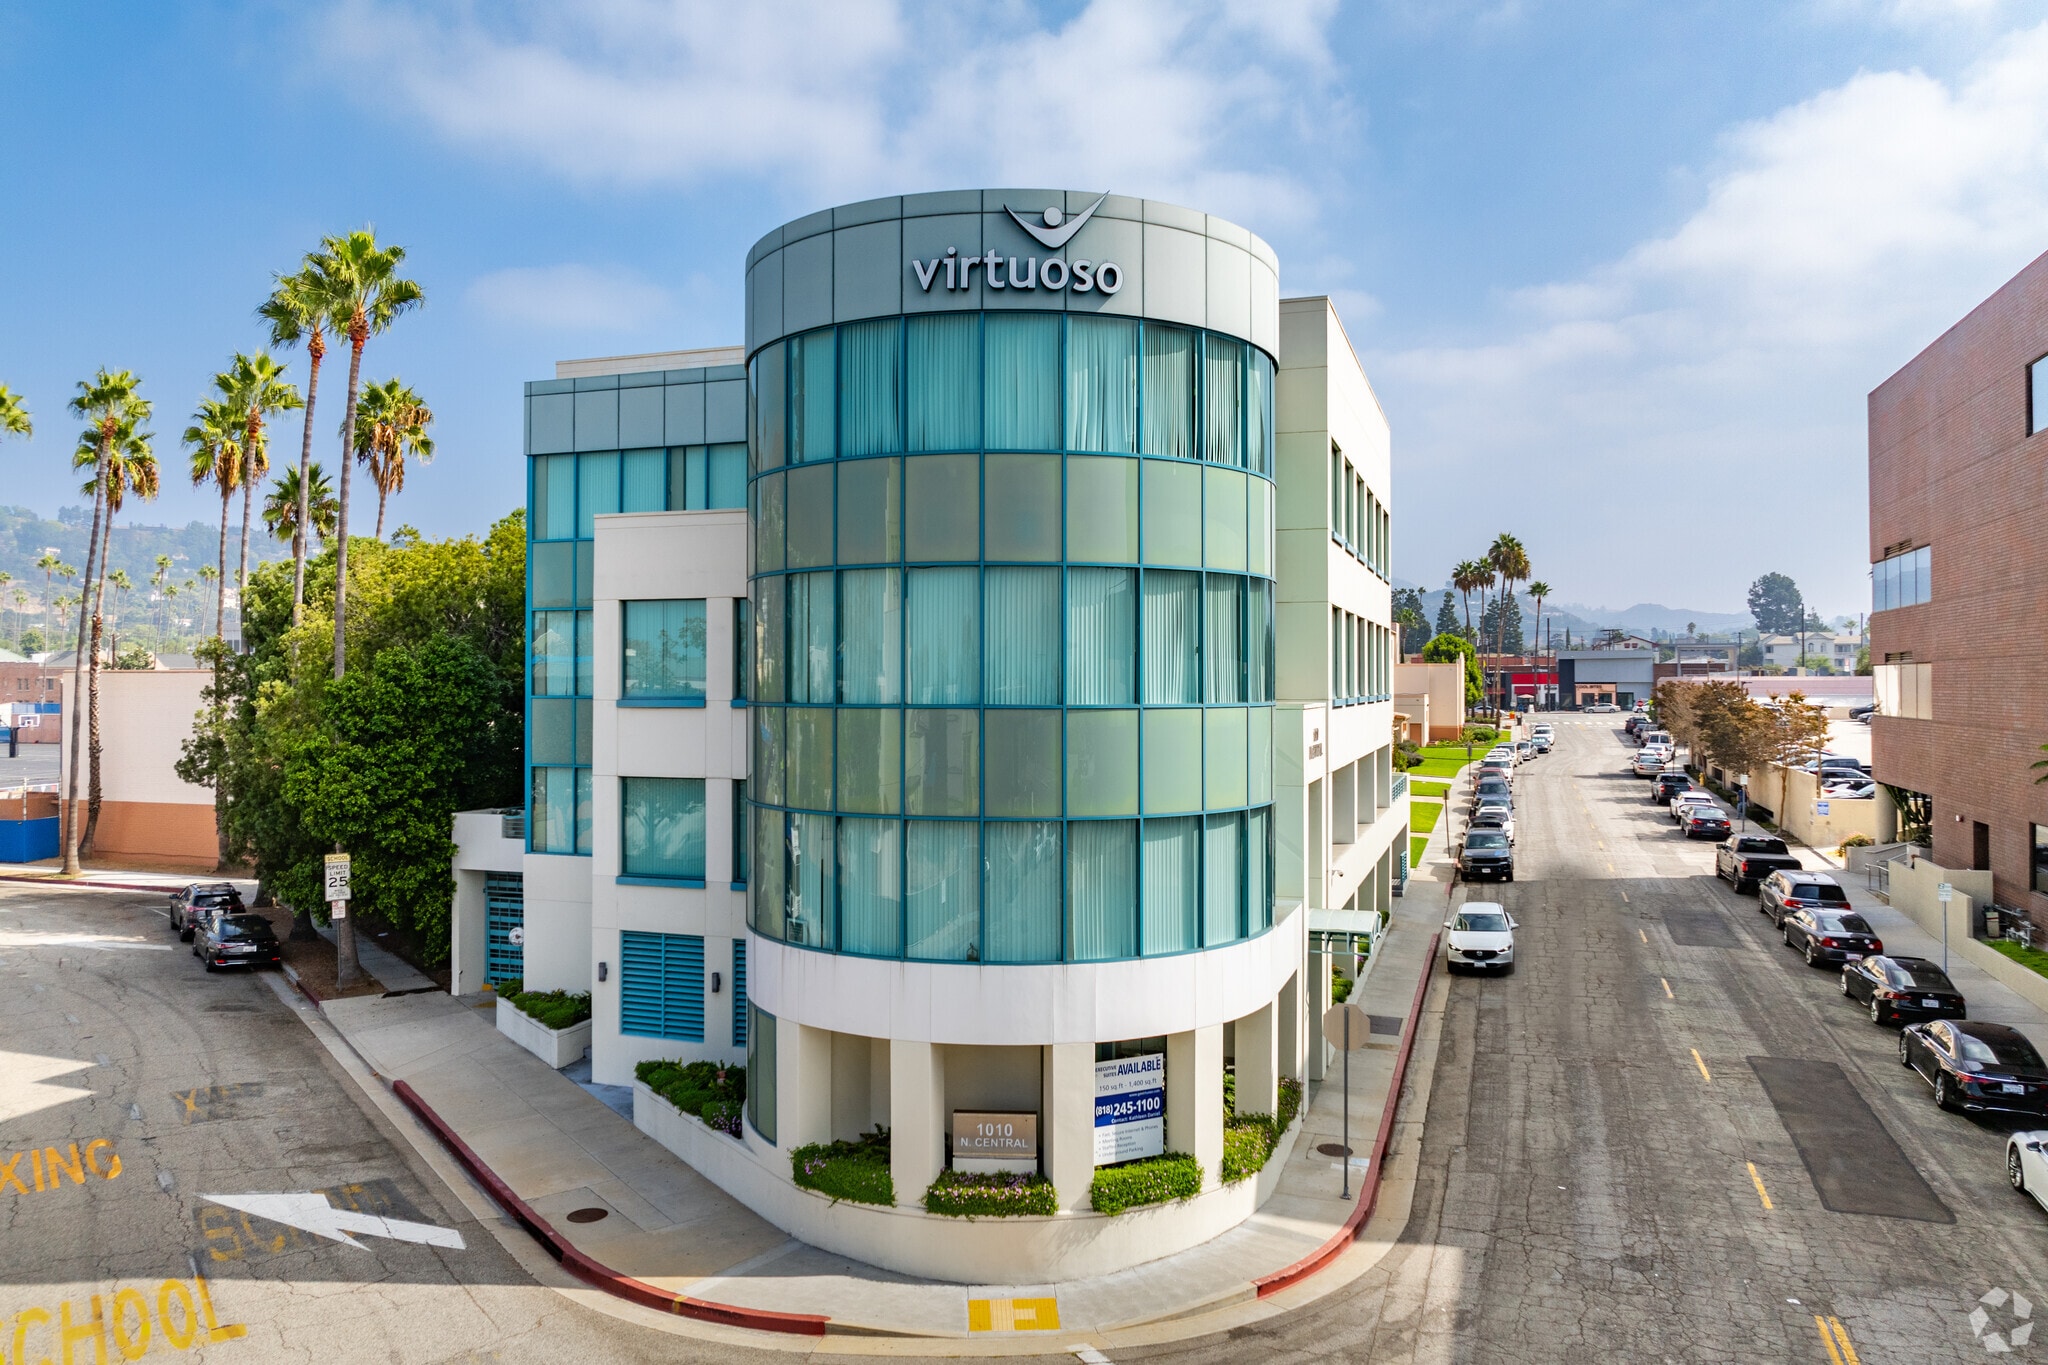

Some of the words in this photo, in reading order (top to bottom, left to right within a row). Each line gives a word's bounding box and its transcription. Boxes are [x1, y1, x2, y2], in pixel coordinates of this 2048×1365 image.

[912, 246, 1124, 294] virtuoso
[328, 876, 348, 888] 25
[1095, 1065, 1117, 1073] EXECUTIVE
[1117, 1059, 1161, 1076] AVAILABLE
[1129, 1080, 1143, 1088] 1,400
[1095, 1104, 1113, 1117] (818)
[1113, 1097, 1160, 1116] 245-1100
[976, 1123, 1013, 1137] 1010
[960, 1137, 971, 1147] N.
[975, 1138, 1028, 1148] CENTRAL
[0, 1138, 123, 1195] XING
[0, 1274, 247, 1365] CHOOL
